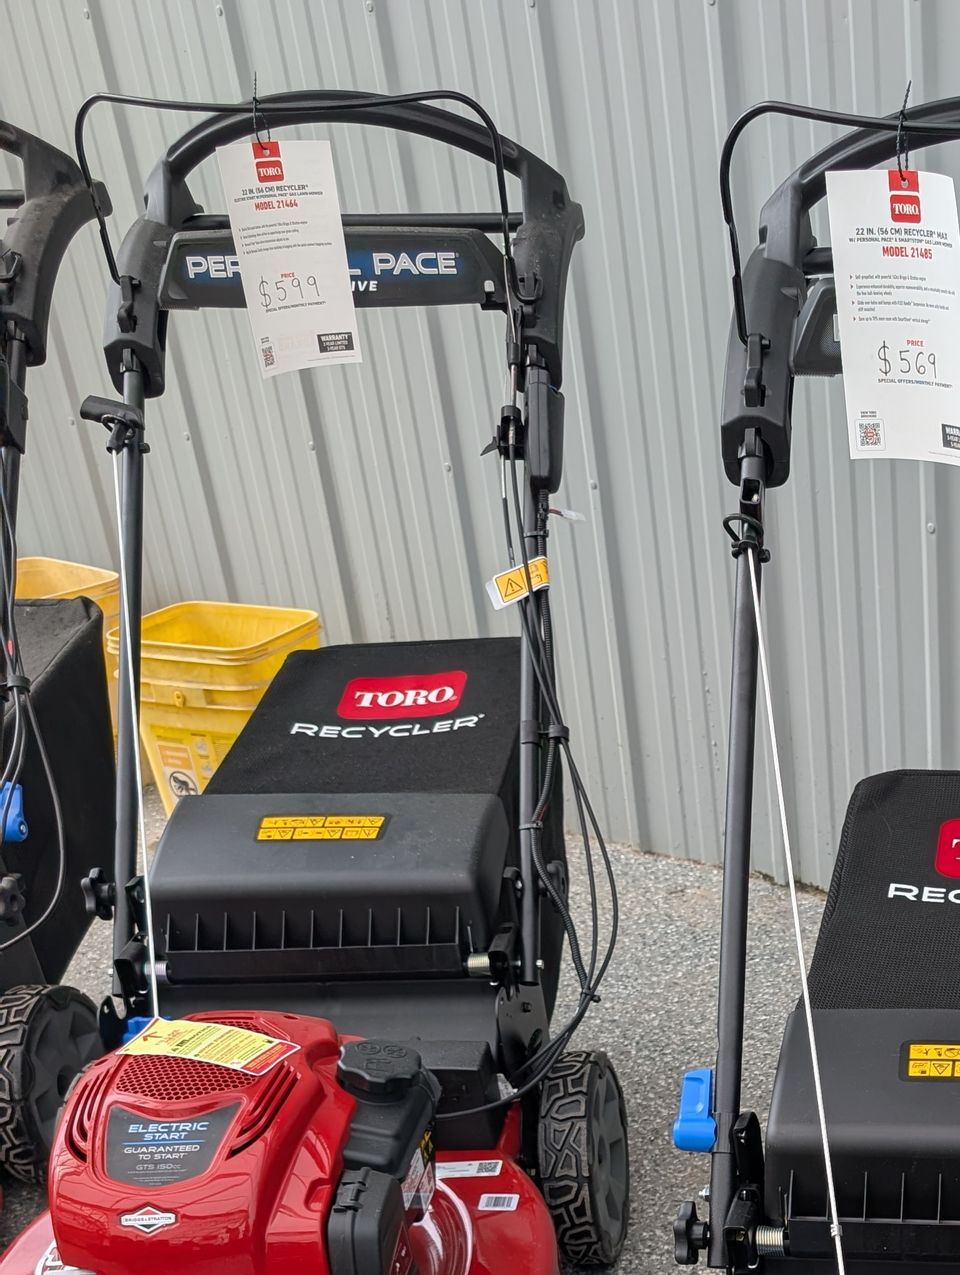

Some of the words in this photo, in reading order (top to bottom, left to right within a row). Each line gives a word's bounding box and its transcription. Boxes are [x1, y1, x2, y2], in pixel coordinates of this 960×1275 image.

[258, 167, 282, 177] TORO
[255, 201, 275, 211] MODEL
[277, 199, 298, 209] 21464
[893, 203, 919, 215] TORO
[856, 228, 864, 236] 22
[866, 228, 876, 236] IN.
[877, 227, 888, 236] (56
[890, 228, 902, 236] CM)
[937, 231, 948, 240] MAX
[882, 246, 908, 257] MODEL
[911, 247, 933, 259] 21485
[259, 275, 320, 308] $599
[877, 340, 937, 379] $569
[128, 1122, 210, 1133] ELECTRIC
[144, 1132, 189, 1141] START
[124, 1145, 200, 1154] GUARANTEED
